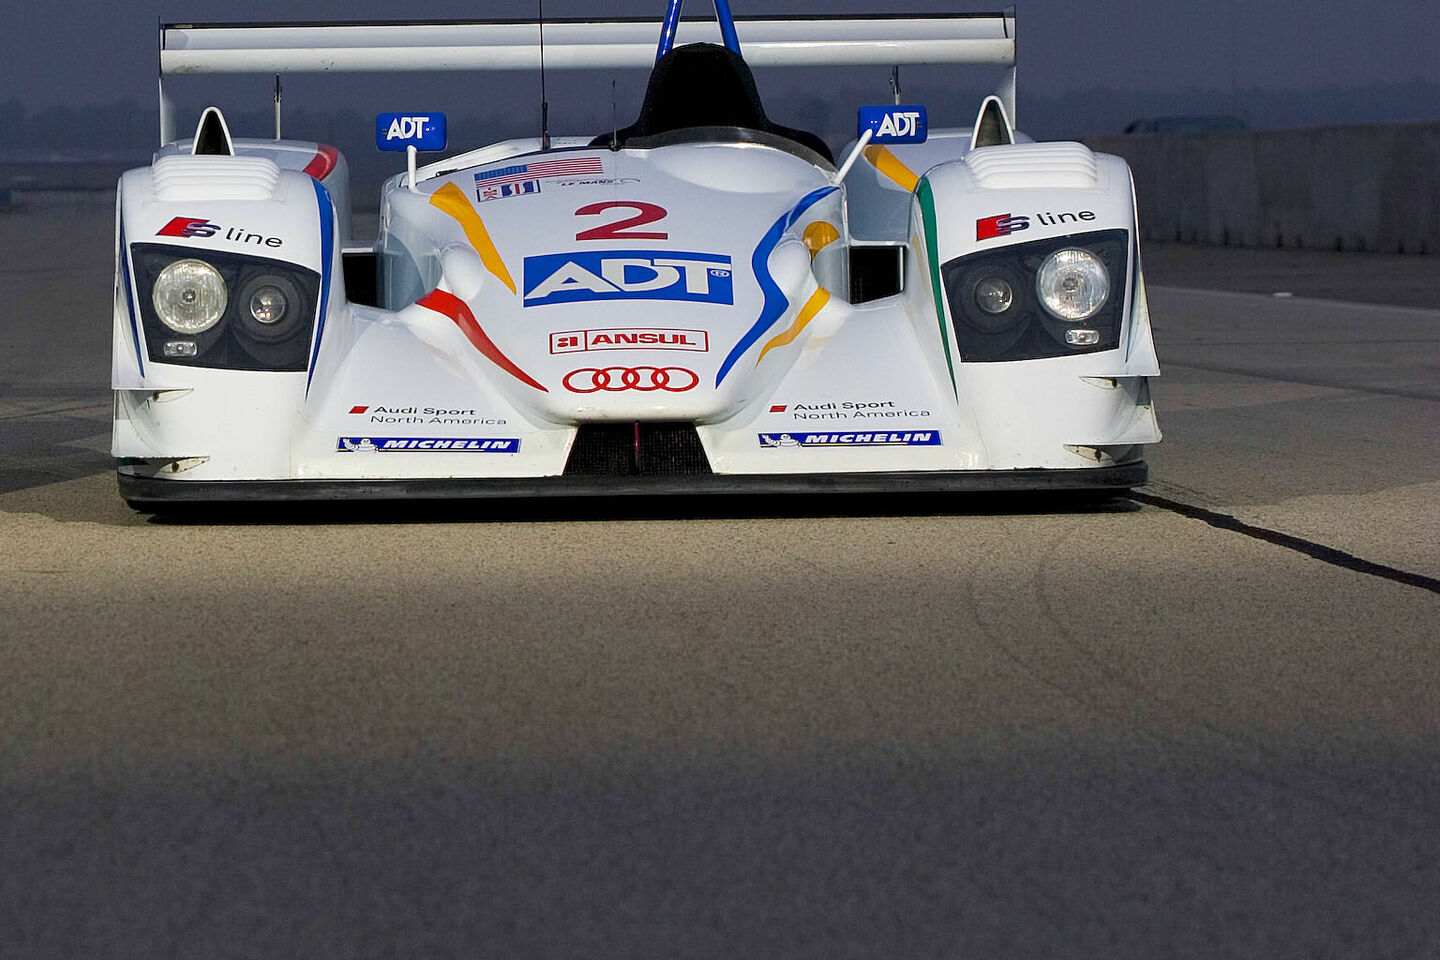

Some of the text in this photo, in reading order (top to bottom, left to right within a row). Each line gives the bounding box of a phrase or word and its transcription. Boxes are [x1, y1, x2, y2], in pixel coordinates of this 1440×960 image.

[386, 117, 429, 140] ADT
[875, 112, 920, 137] ADT
[574, 201, 668, 241] 2
[1037, 211, 1096, 225] line
[226, 227, 283, 248] line
[524, 258, 732, 300] ADT
[591, 333, 696, 346] ANSUL
[374, 406, 476, 416] Audi Sport
[794, 401, 895, 410] Audi Sport
[370, 416, 507, 425] North America
[794, 409, 930, 420] North America
[805, 432, 931, 443] MICHELIN
[383, 440, 511, 449] MICHELIN
